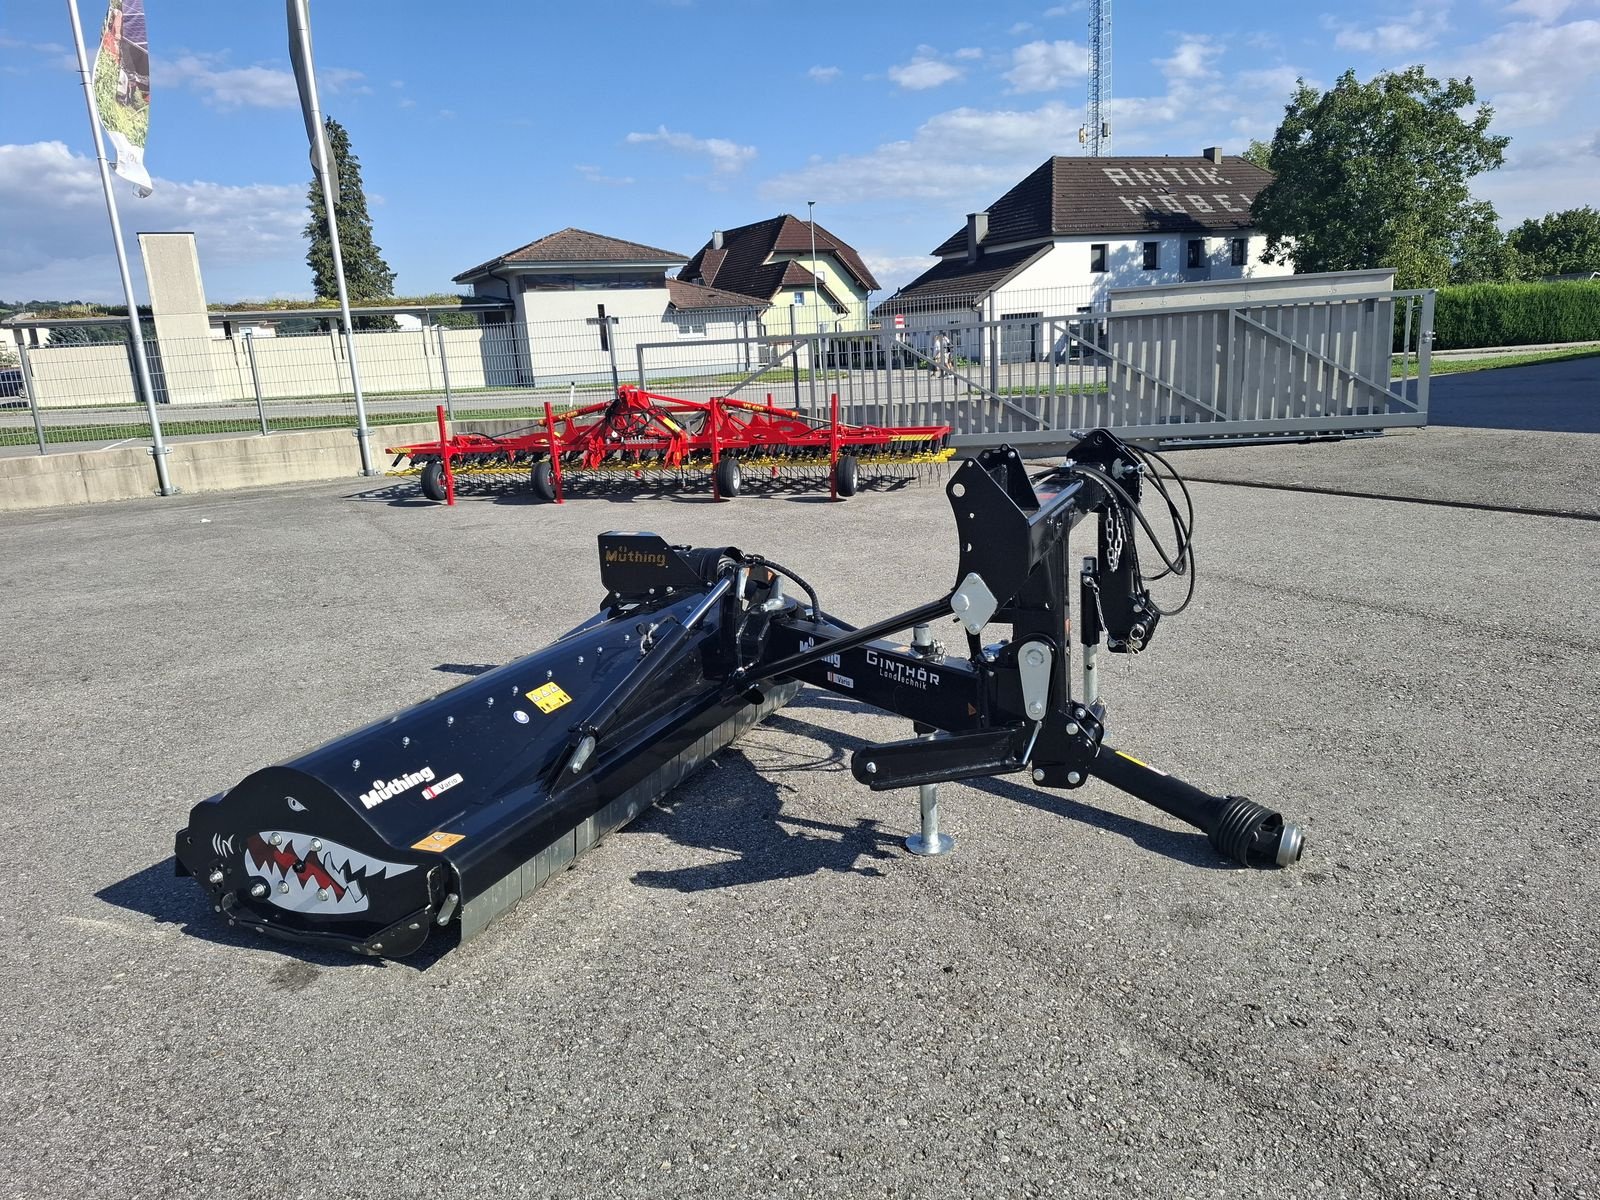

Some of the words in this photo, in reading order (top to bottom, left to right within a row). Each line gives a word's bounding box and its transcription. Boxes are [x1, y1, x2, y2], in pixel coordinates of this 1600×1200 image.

[605, 545, 666, 567] Müthing
[359, 766, 436, 810] Müthing
[438, 777, 459, 790] Vario
